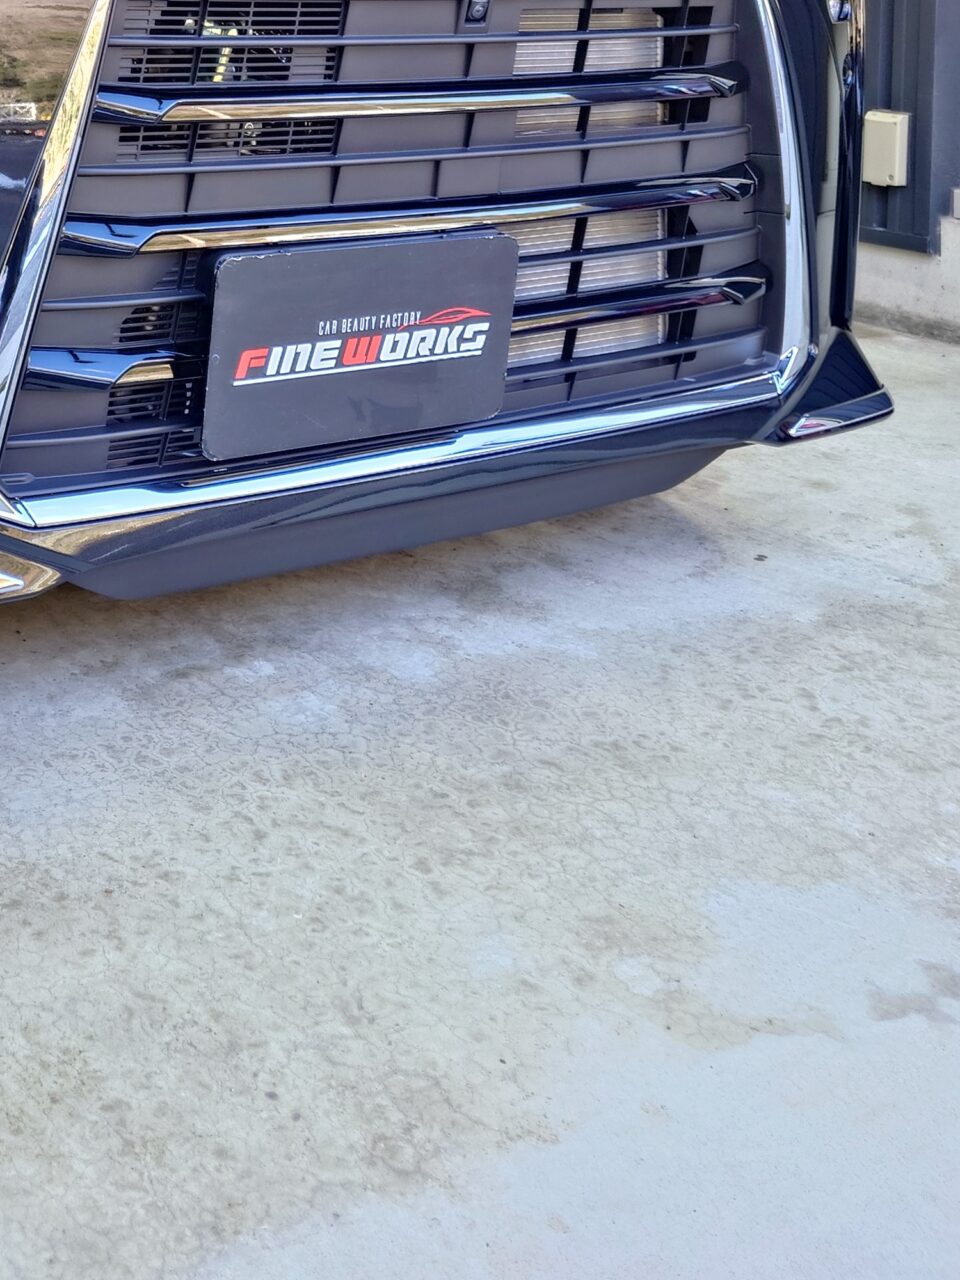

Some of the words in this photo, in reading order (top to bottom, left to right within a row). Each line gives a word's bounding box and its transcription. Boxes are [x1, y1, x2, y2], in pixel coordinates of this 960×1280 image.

[318, 320, 338, 336] CAR
[341, 315, 377, 333] BEAUTY
[379, 311, 422, 329] FACTORY
